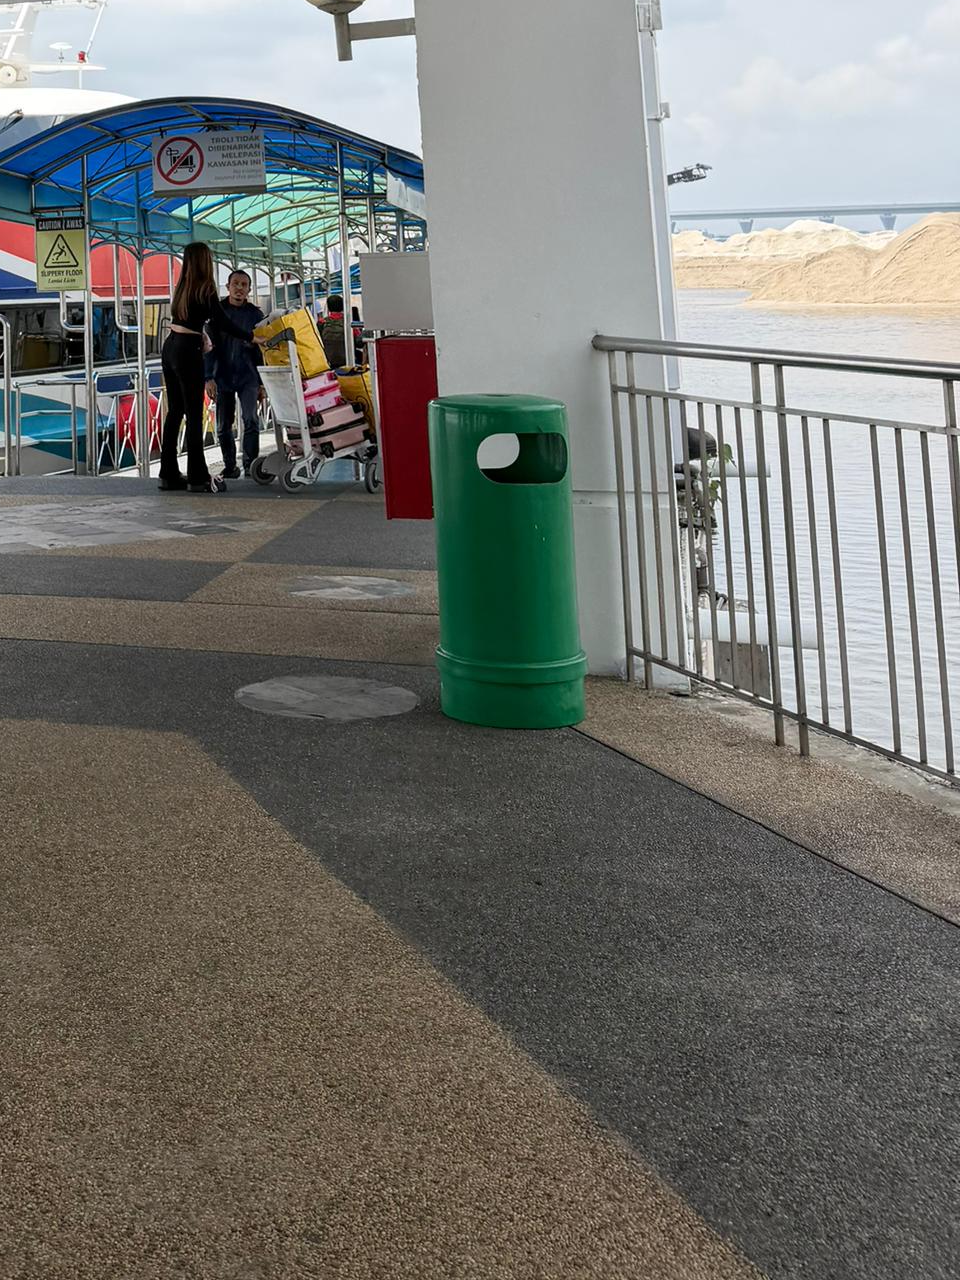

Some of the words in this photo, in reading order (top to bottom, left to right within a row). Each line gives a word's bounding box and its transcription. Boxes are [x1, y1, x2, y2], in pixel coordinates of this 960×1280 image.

[208, 143, 260, 151] DIBENARKAN
[221, 151, 261, 159] MELEPASI
[208, 160, 249, 168] KAWASAN
[250, 158, 262, 166] INI
[39, 220, 61, 230] CAUTION
[66, 219, 83, 229] AWAS
